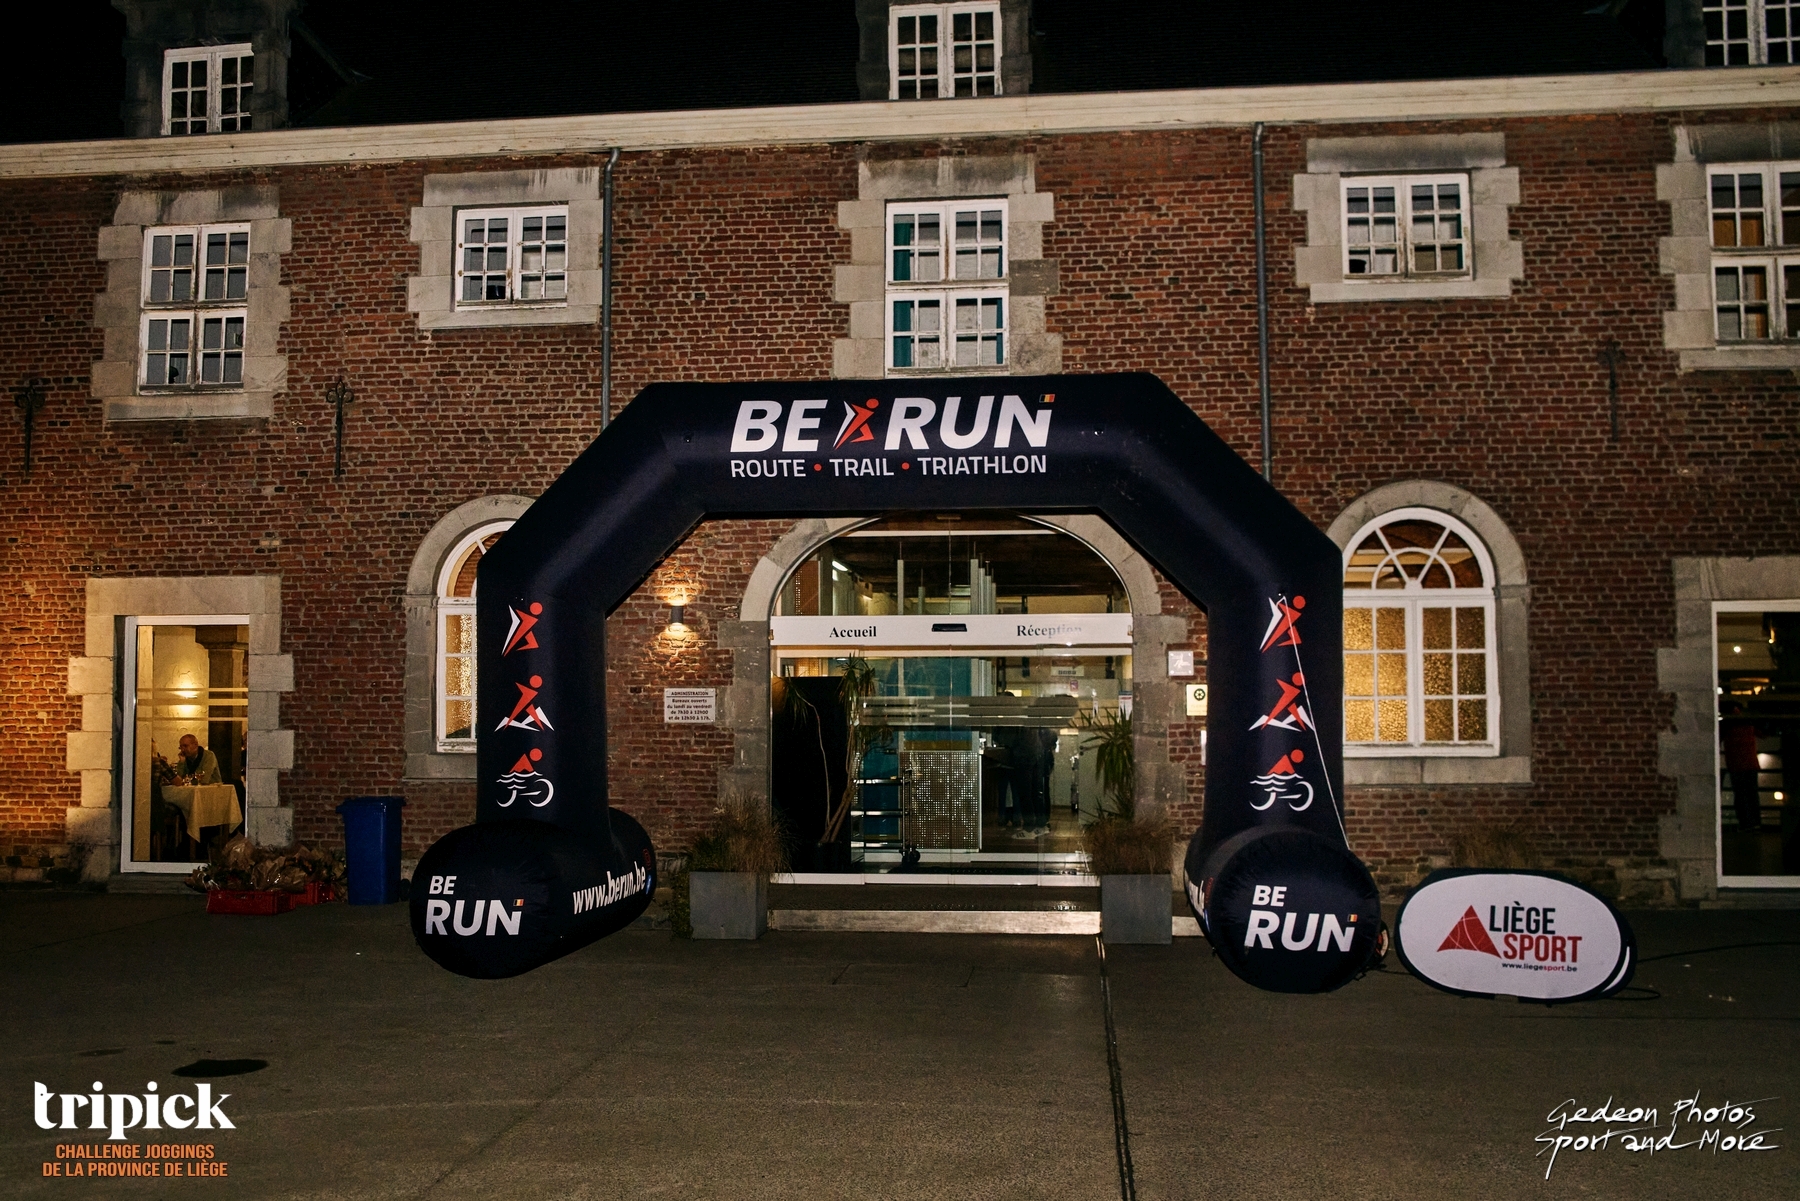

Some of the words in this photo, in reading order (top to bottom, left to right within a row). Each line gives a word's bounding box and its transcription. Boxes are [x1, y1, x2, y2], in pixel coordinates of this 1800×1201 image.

[730, 399, 828, 453] BE
[884, 394, 1053, 451] RUN
[730, 458, 807, 478] ROUTE
[829, 457, 895, 477] TRAIL
[917, 454, 1047, 476] TRIATHLON
[829, 625, 877, 638] Accueil
[1016, 624, 1082, 639] Réception
[429, 875, 457, 895] BE
[572, 861, 646, 915] www.berun.be
[1252, 885, 1288, 907] BE
[425, 898, 522, 936] RUN
[1489, 900, 1556, 935] LIÈGE
[1244, 910, 1355, 952] RUN
[1503, 933, 1583, 963] SPORT
[1501, 962, 1578, 972] www.liegesport.be
